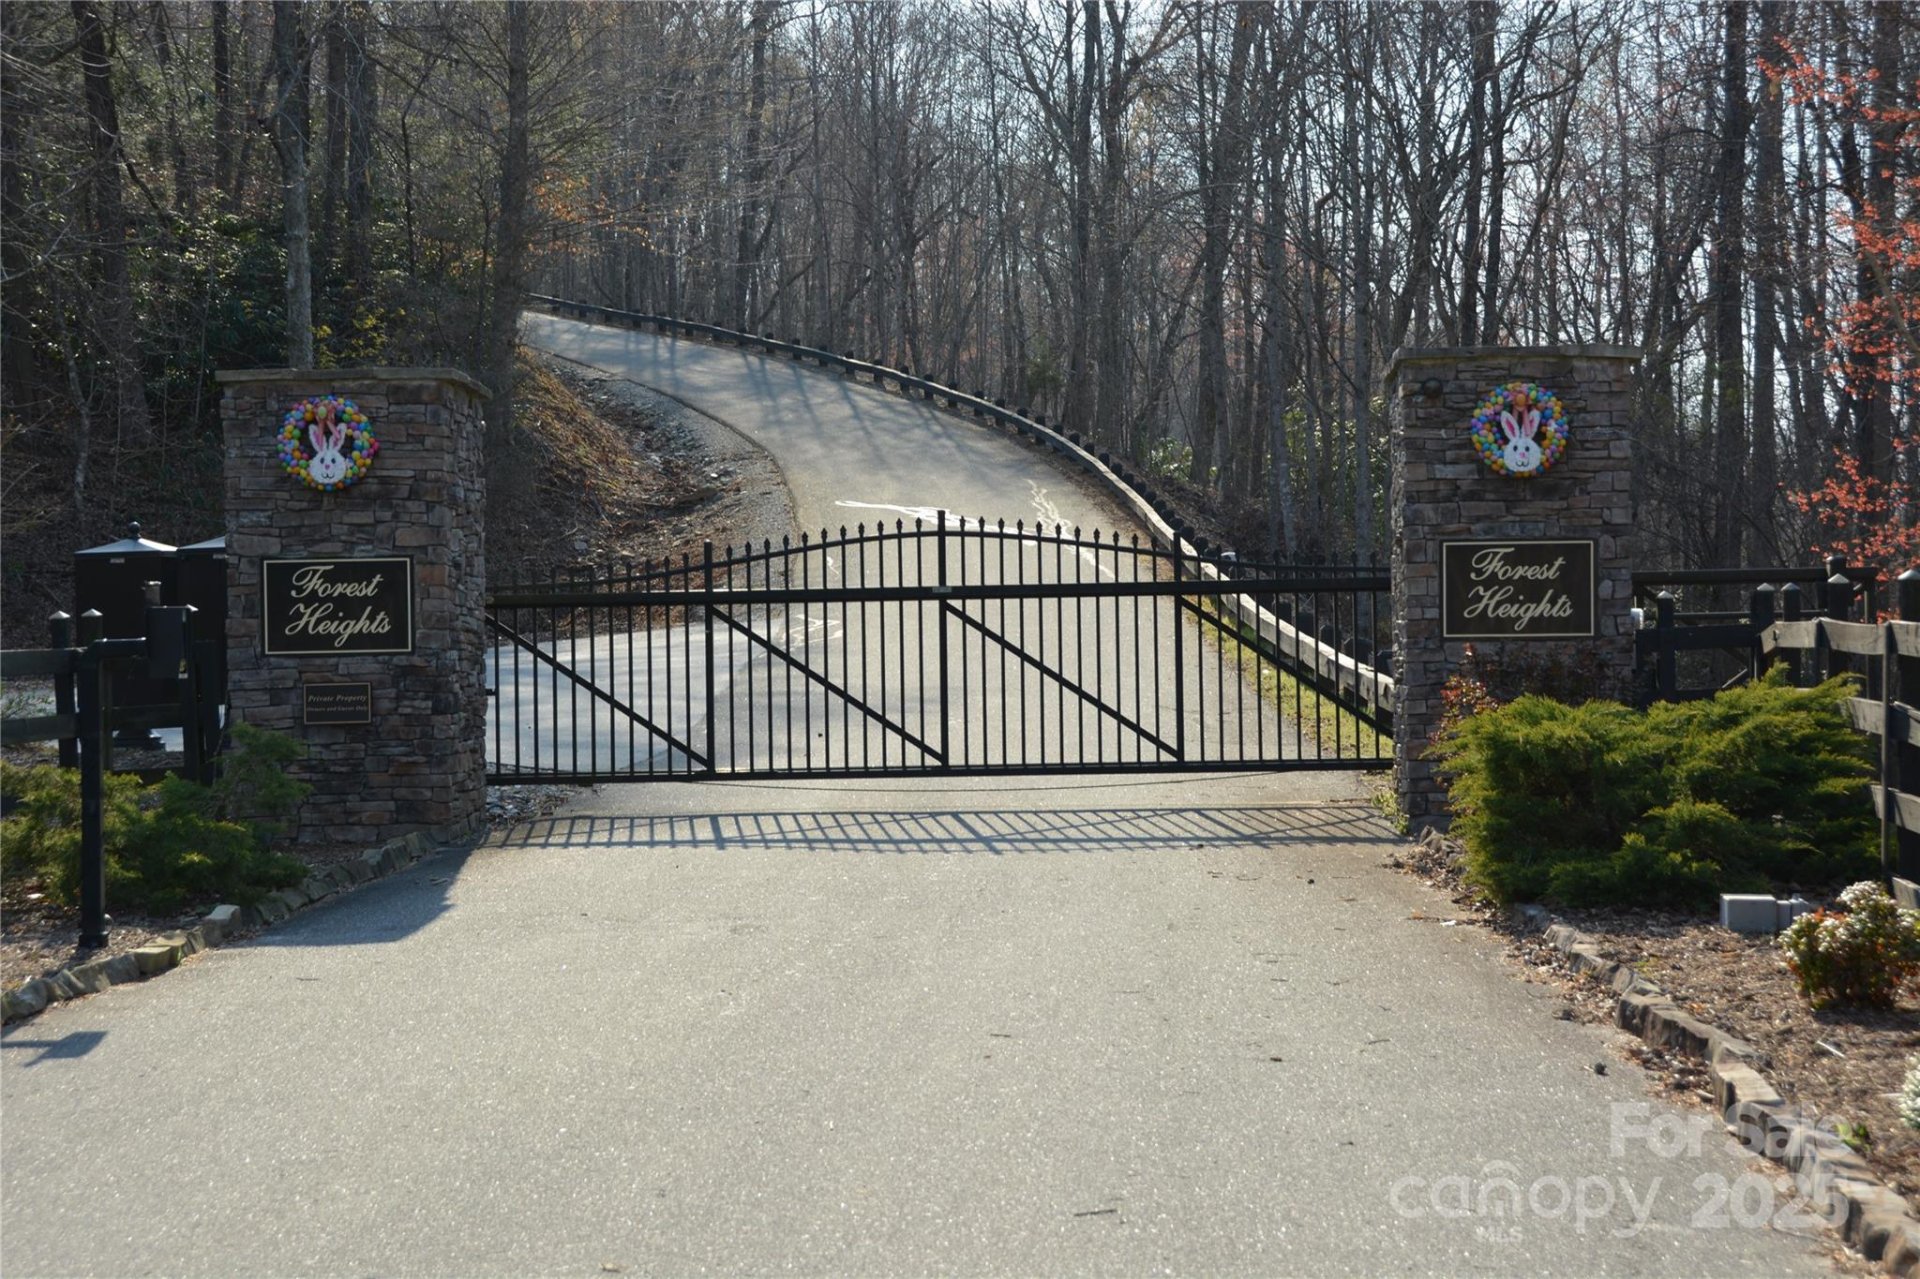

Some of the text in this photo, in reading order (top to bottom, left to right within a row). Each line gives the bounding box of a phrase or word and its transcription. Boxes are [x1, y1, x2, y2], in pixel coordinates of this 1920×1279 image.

[290, 565, 384, 598] Forest
[1470, 547, 1566, 580] Forest
[284, 602, 392, 647] Heights
[1463, 585, 1573, 631] Heights
